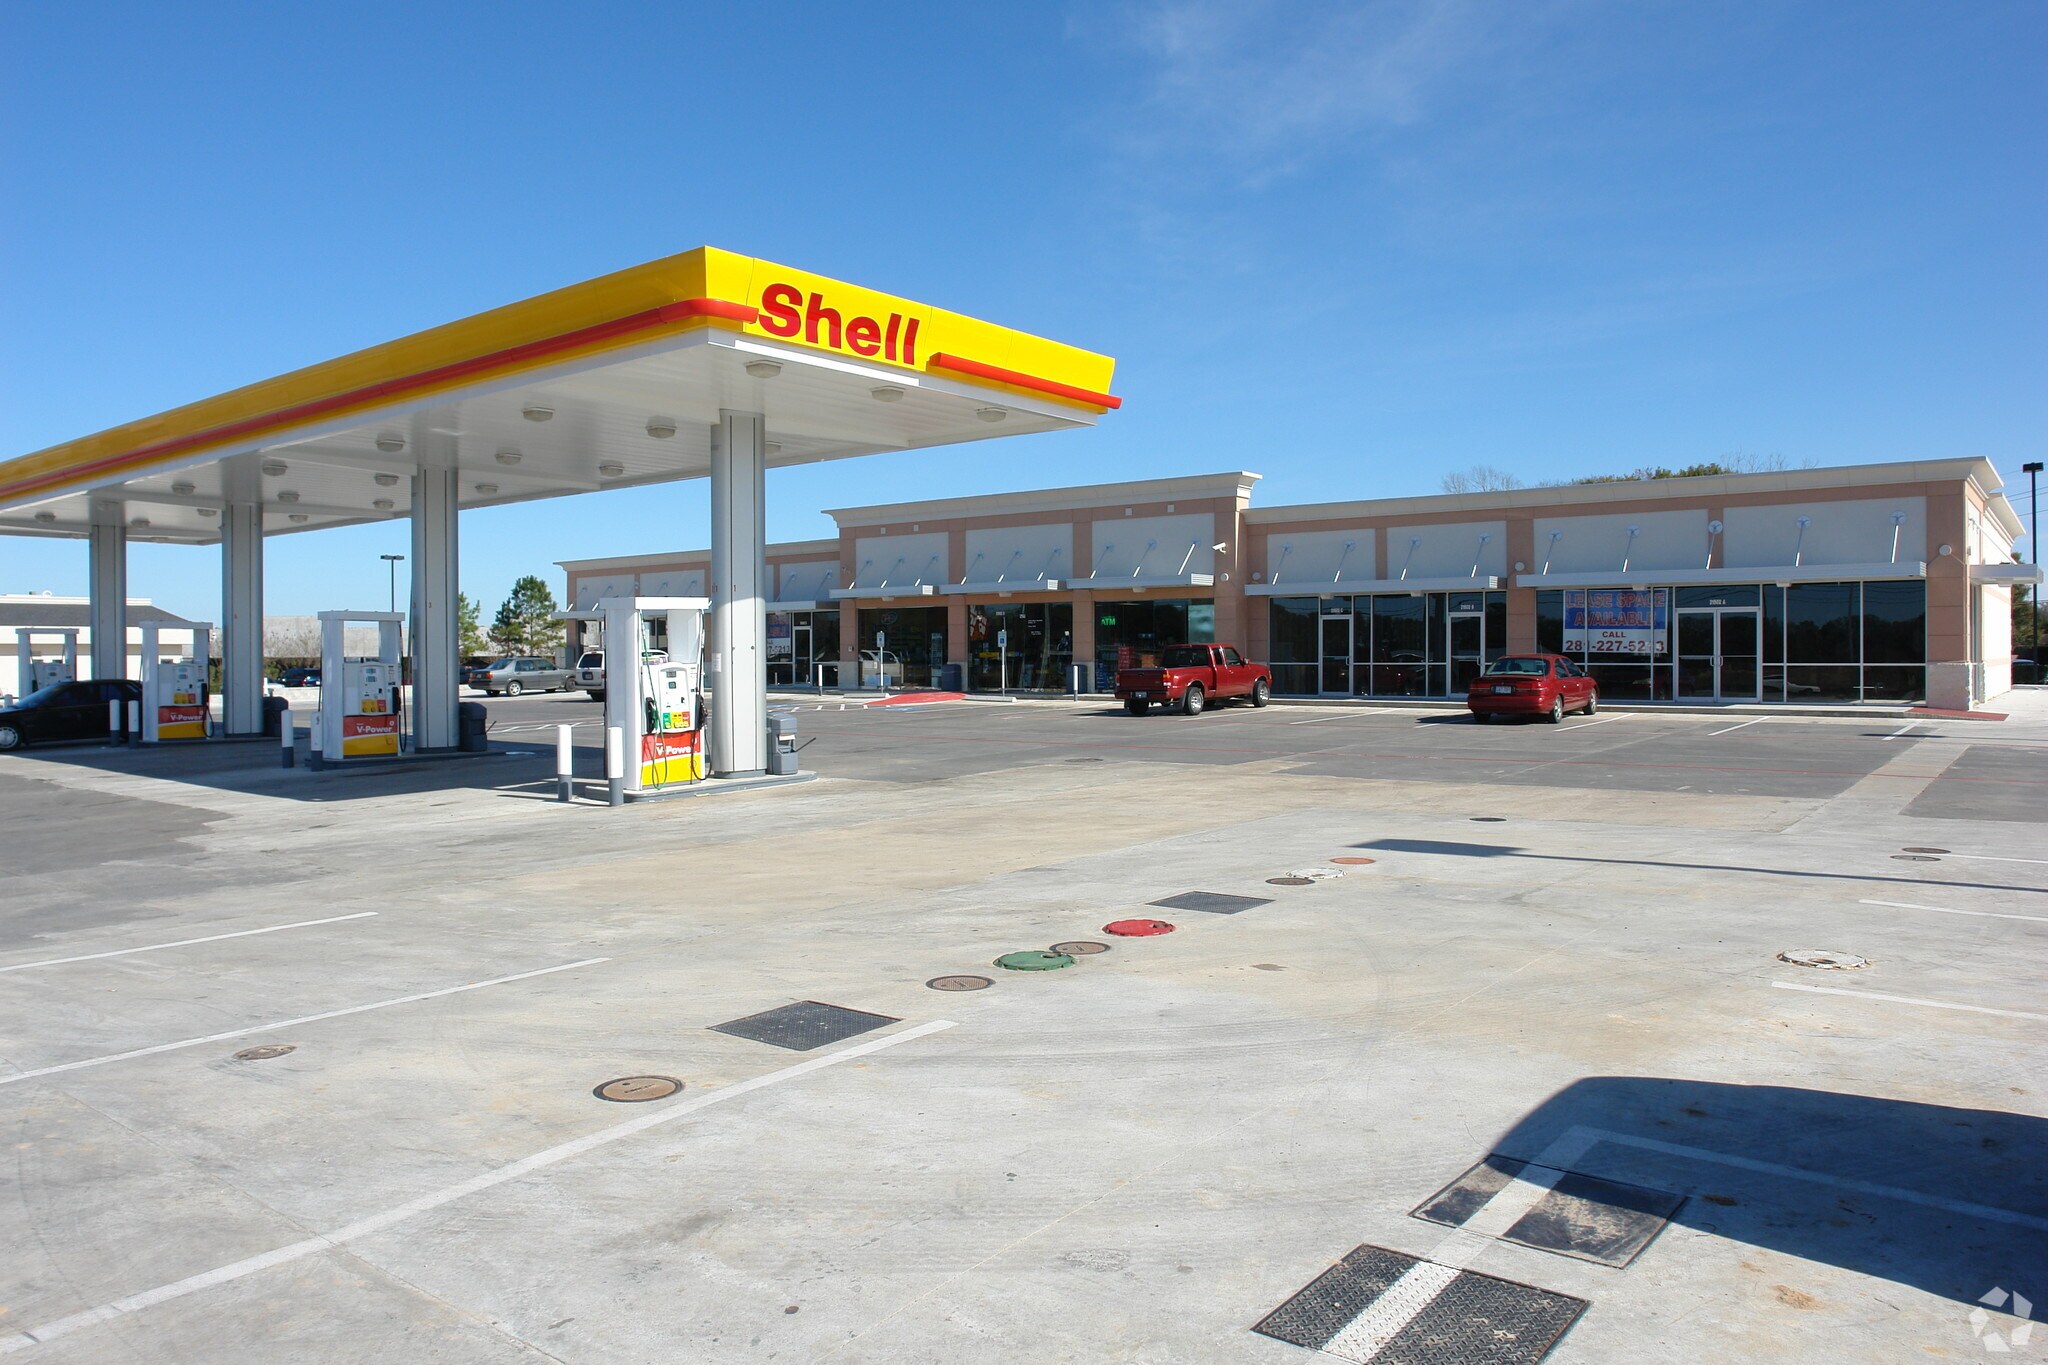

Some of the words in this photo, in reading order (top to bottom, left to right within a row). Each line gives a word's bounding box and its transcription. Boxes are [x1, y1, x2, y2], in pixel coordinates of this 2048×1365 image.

[758, 283, 920, 365] Shell
[1566, 593, 1613, 608] LEASE
[1617, 592, 1665, 607] SPACE
[1101, 618, 1116, 626] ATM
[1574, 612, 1657, 626] AVAILABLE
[1565, 640, 1665, 652] 281-227-523
[356, 725, 393, 733] V-Power
[656, 745, 693, 756] V-Powe
